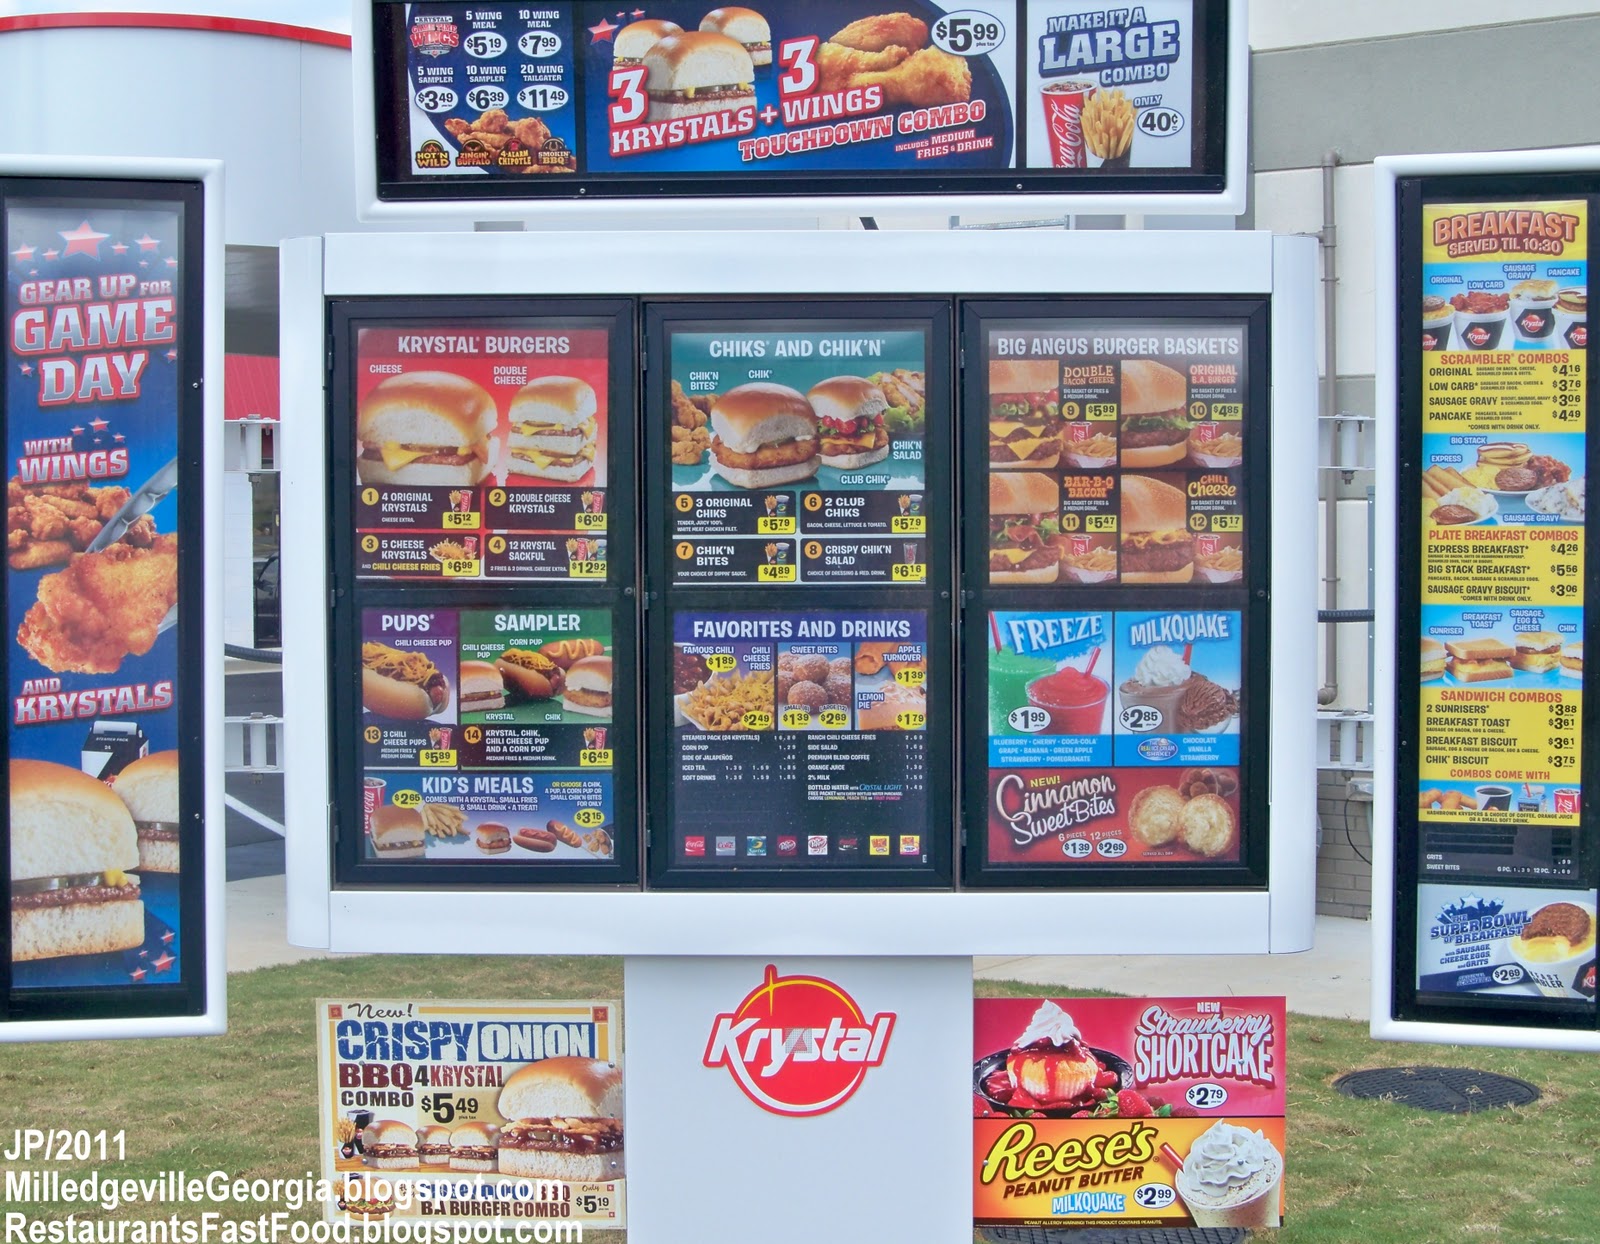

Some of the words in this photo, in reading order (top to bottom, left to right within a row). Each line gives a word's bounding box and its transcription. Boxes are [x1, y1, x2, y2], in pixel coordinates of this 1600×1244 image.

[466, 11, 472, 19] 5
[475, 12, 502, 20] WING
[519, 10, 529, 19] 10
[533, 11, 559, 19] WING
[1048, 12, 1104, 33] MAKE
[1108, 9, 1128, 28] IT
[1133, 8, 1146, 23] A
[410, 32, 459, 46] WINGS
[1042, 23, 1177, 69] LARGE
[418, 67, 424, 75] 5
[427, 67, 453, 75] WING
[466, 66, 477, 74] 10
[521, 65, 534, 73] 20
[537, 65, 563, 73] WING
[782, 39, 815, 93] 3
[1101, 63, 1168, 84] COMBO
[612, 69, 644, 123] 3
[1135, 95, 1162, 106] ONLY
[783, 87, 881, 123] WINGS
[613, 109, 754, 153] KRYSTALS
[738, 115, 893, 161] TOUCHDOWN
[898, 100, 985, 133] COMBO
[896, 141, 929, 152] INCLUDES
[932, 130, 974, 145] MEDIUM
[917, 146, 948, 159] FRIES
[957, 138, 993, 152] DRINK
[1435, 211, 1578, 244] BREAKFAST
[1449, 238, 1497, 256] SERVED
[1502, 238, 1520, 250] TIL
[1523, 238, 1561, 254] 10:30
[21, 279, 91, 303] GEAR
[101, 275, 136, 297] UP
[140, 281, 171, 295] FOR
[14, 300, 173, 352] GAME
[1522, 320, 1545, 328] Krystal
[486, 337, 569, 353] BURGERS
[775, 340, 812, 357] AND
[819, 339, 881, 357] CHIK'N
[998, 338, 1025, 355] BIG
[1031, 338, 1088, 355] ANGUS
[1093, 338, 1159, 354] BURGER
[1164, 338, 1239, 354] BASKETS
[1518, 353, 1569, 364] COMBOS
[370, 365, 402, 373] CHEESE
[494, 367, 527, 375] DOUBLE
[690, 372, 718, 380] CHIK'N
[1064, 366, 1113, 377] DOUBLE
[1190, 365, 1237, 375] ORIGINAL
[1429, 368, 1472, 376] ORIGINAL
[42, 354, 145, 402] DAY
[494, 376, 526, 384] CHEESE
[25, 438, 72, 455] WITH
[893, 441, 922, 450] CHIK'N
[893, 451, 921, 460] SALAD
[20, 450, 128, 483] WINGS
[382, 493, 388, 501] 4
[391, 493, 432, 501] ORIGINAL
[1188, 482, 1236, 498] Cheese
[382, 503, 427, 512] KRYSTALS
[1429, 531, 1461, 540] PLATE
[1465, 530, 1526, 540] BREAKFAST
[1530, 531, 1578, 540] COMBOS
[825, 546, 858, 554] CRISPY
[861, 546, 891, 554] CHIK'N
[382, 614, 429, 631] PUPS
[495, 614, 580, 631] SAMPLER
[694, 621, 792, 638] FAVORITES
[798, 621, 836, 638] AND
[842, 621, 910, 638] DRINKS
[1131, 615, 1228, 646] MILKQUAKE
[1008, 615, 1103, 654] FREEZE
[883, 654, 921, 662] TURNOVER
[22, 678, 60, 695] AND
[16, 682, 172, 722] KRYSTALS
[859, 693, 884, 701] LEMON
[1441, 691, 1505, 702] SANDWICH
[1509, 692, 1562, 702] COMBOS
[1427, 718, 1478, 726] BREAKFAST
[1482, 719, 1510, 727] TOAST
[1453, 756, 1488, 764] BISCUIT
[1030, 775, 1060, 787] NEW!
[1450, 769, 1491, 778] COMBOS
[1495, 770, 1522, 779] COME
[1526, 771, 1550, 779] WITH
[422, 778, 468, 793] KID'S
[475, 777, 533, 793] MEALS
[996, 775, 1115, 821] Cinnamon
[1011, 803, 1072, 844] Sweet
[1075, 793, 1115, 822] Bites
[1431, 921, 1480, 938] SUPER
[1482, 910, 1532, 929] BOWL
[1455, 925, 1523, 945] BREAKFAST
[348, 1003, 413, 1019] New!
[1197, 1003, 1220, 1013] NEW
[1137, 1006, 1271, 1044] Strawberry
[337, 1020, 474, 1061] CRISPY
[480, 1023, 590, 1059] ONION
[708, 1017, 891, 1077] Krystal
[1135, 1033, 1275, 1084] SHORTCAKE
[339, 1063, 413, 1090] BBQ
[430, 1066, 505, 1087] KRYSTAL
[341, 1091, 414, 1107] COMBO
[981, 1122, 1158, 1184] Reese's
[1003, 1177, 1075, 1198] PEANUT
[1079, 1166, 1144, 1186] BUTTER
[450, 1201, 510, 1216] BURGER
[517, 1202, 570, 1217] COMBO
[1052, 1192, 1125, 1214] MILKQUAKE
